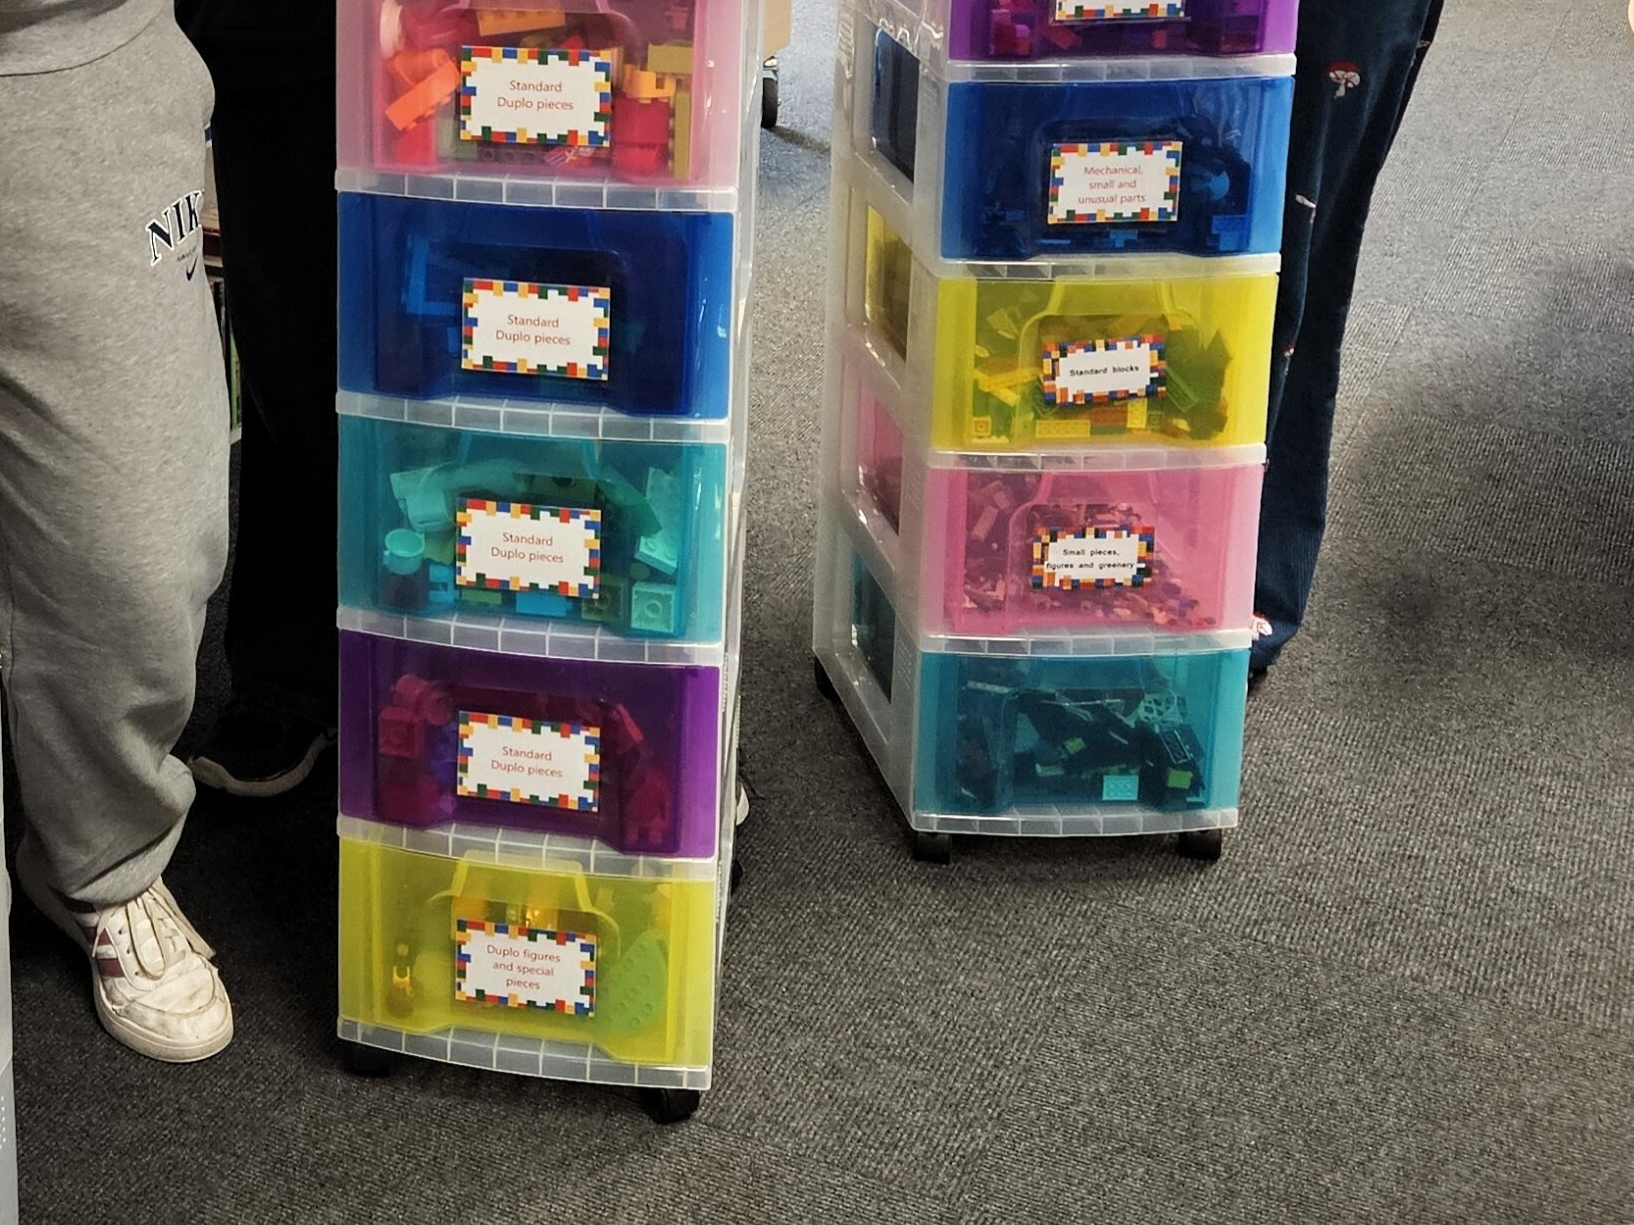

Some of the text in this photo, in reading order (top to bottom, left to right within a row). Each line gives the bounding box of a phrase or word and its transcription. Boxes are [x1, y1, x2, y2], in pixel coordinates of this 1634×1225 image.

[510, 80, 562, 92] Standard
[497, 97, 574, 111] Duplo pieces
[1089, 180, 1136, 189] small and
[1078, 193, 1146, 204] unusual parts
[146, 189, 205, 266] NIK
[508, 314, 559, 328] Standard
[496, 330, 570, 345] Duplo pieces
[1070, 365, 1139, 376] Standard blocks
[503, 532, 553, 546] Standard
[491, 547, 564, 563] Duplo pieces
[1090, 549, 1119, 557] pieces,
[1046, 562, 1074, 570] figures
[502, 746, 552, 761] Standard
[491, 760, 563, 778] Duplo pieces
[487, 945, 560, 962] Duplo figures
[493, 963, 554, 976] and special
[506, 978, 540, 990] pieces
